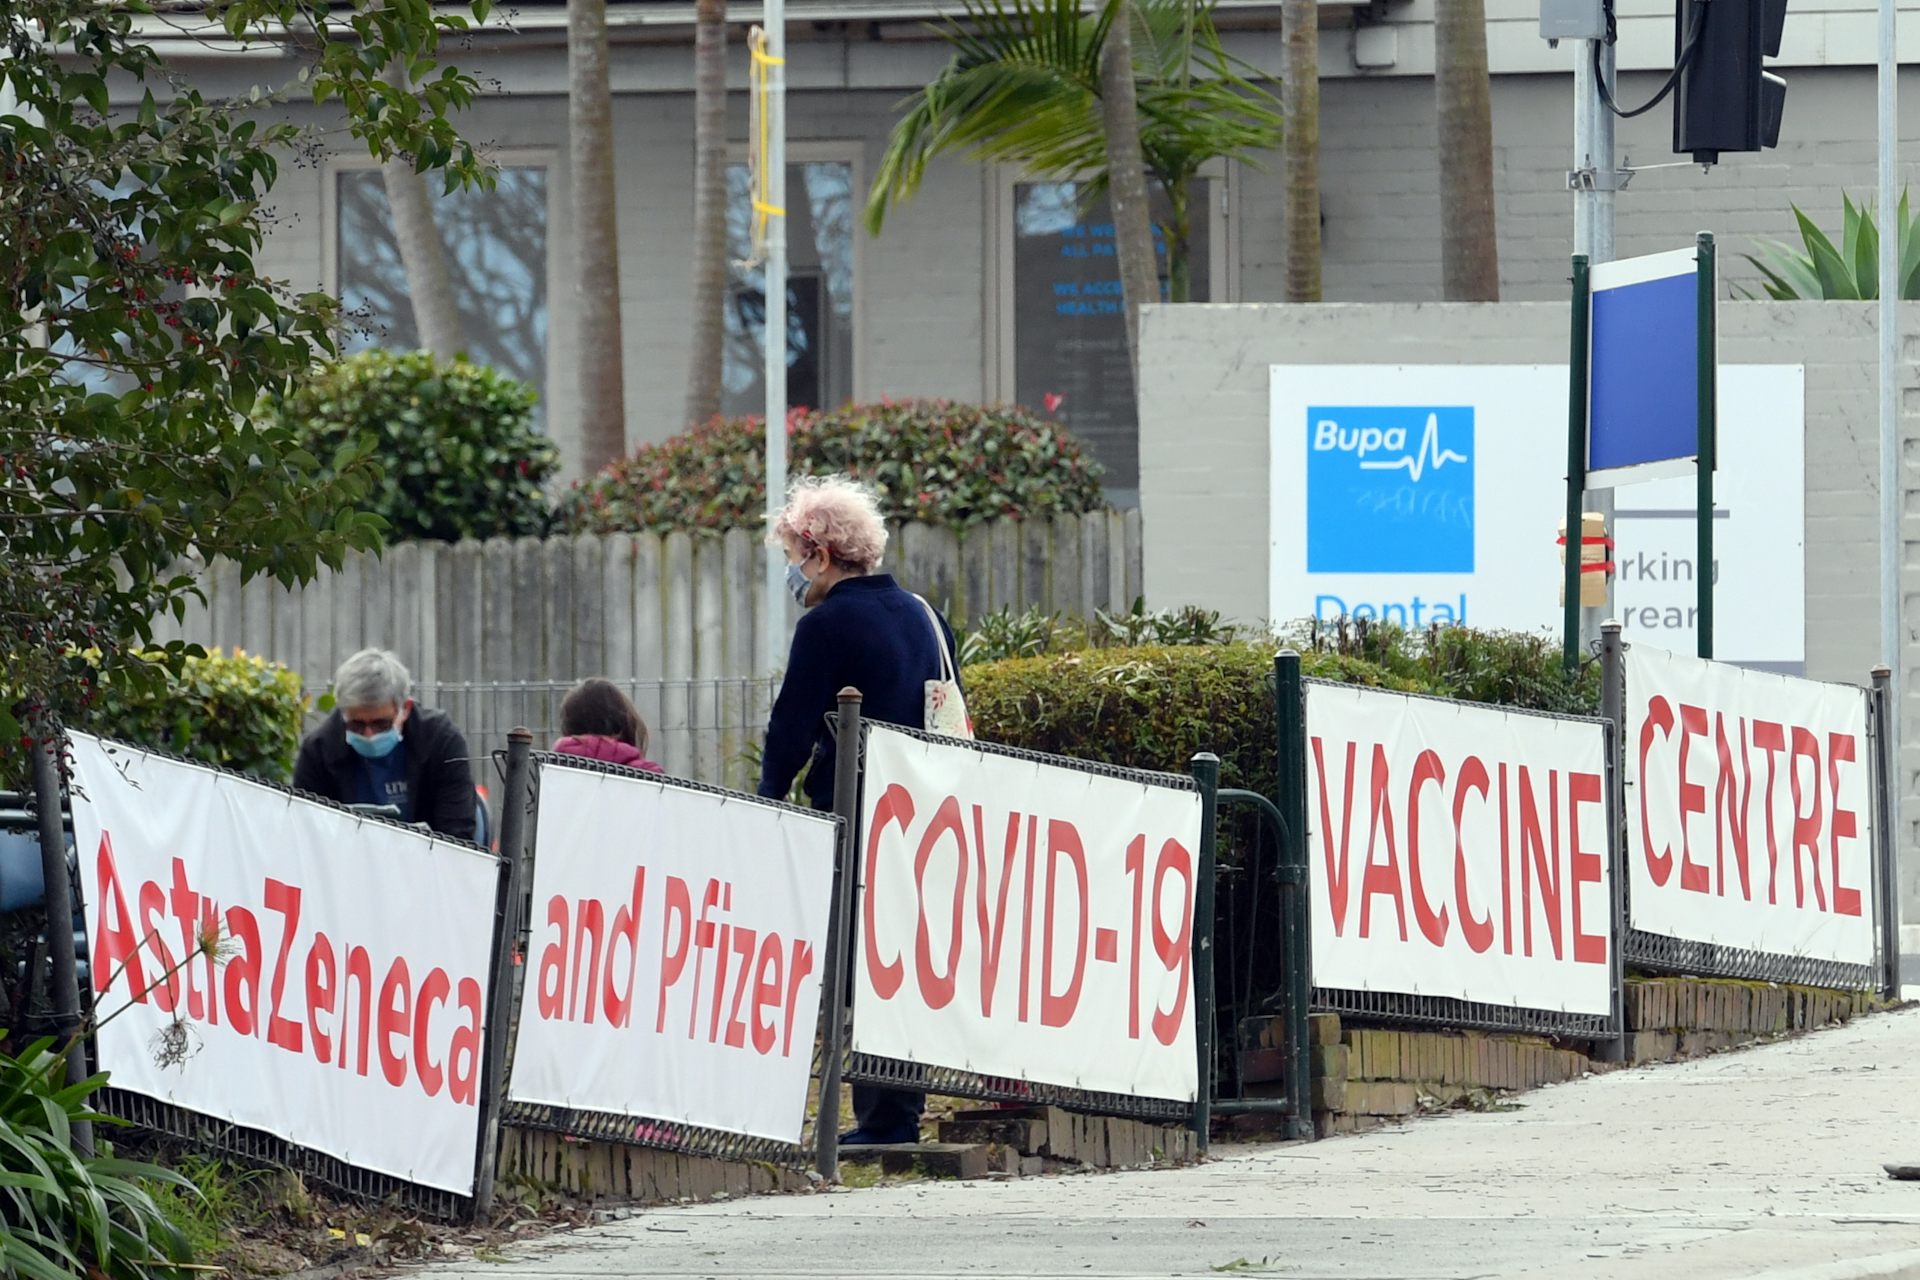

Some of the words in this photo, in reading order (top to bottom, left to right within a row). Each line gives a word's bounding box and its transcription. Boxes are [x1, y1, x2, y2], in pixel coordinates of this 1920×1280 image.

[1055, 282, 1078, 296] WE
[1055, 300, 1118, 315] HEALTH
[1313, 420, 1407, 458] Bupa
[1315, 594, 1467, 629] Dental
[1623, 606, 1698, 629] rear
[1311, 735, 1607, 965] VACCINE
[1639, 694, 1863, 917] CENTRE
[93, 829, 482, 1106] AstraZeneca
[537, 865, 646, 1029] and
[655, 875, 814, 1058] Pfizer
[864, 782, 1193, 1047] COVID-19
